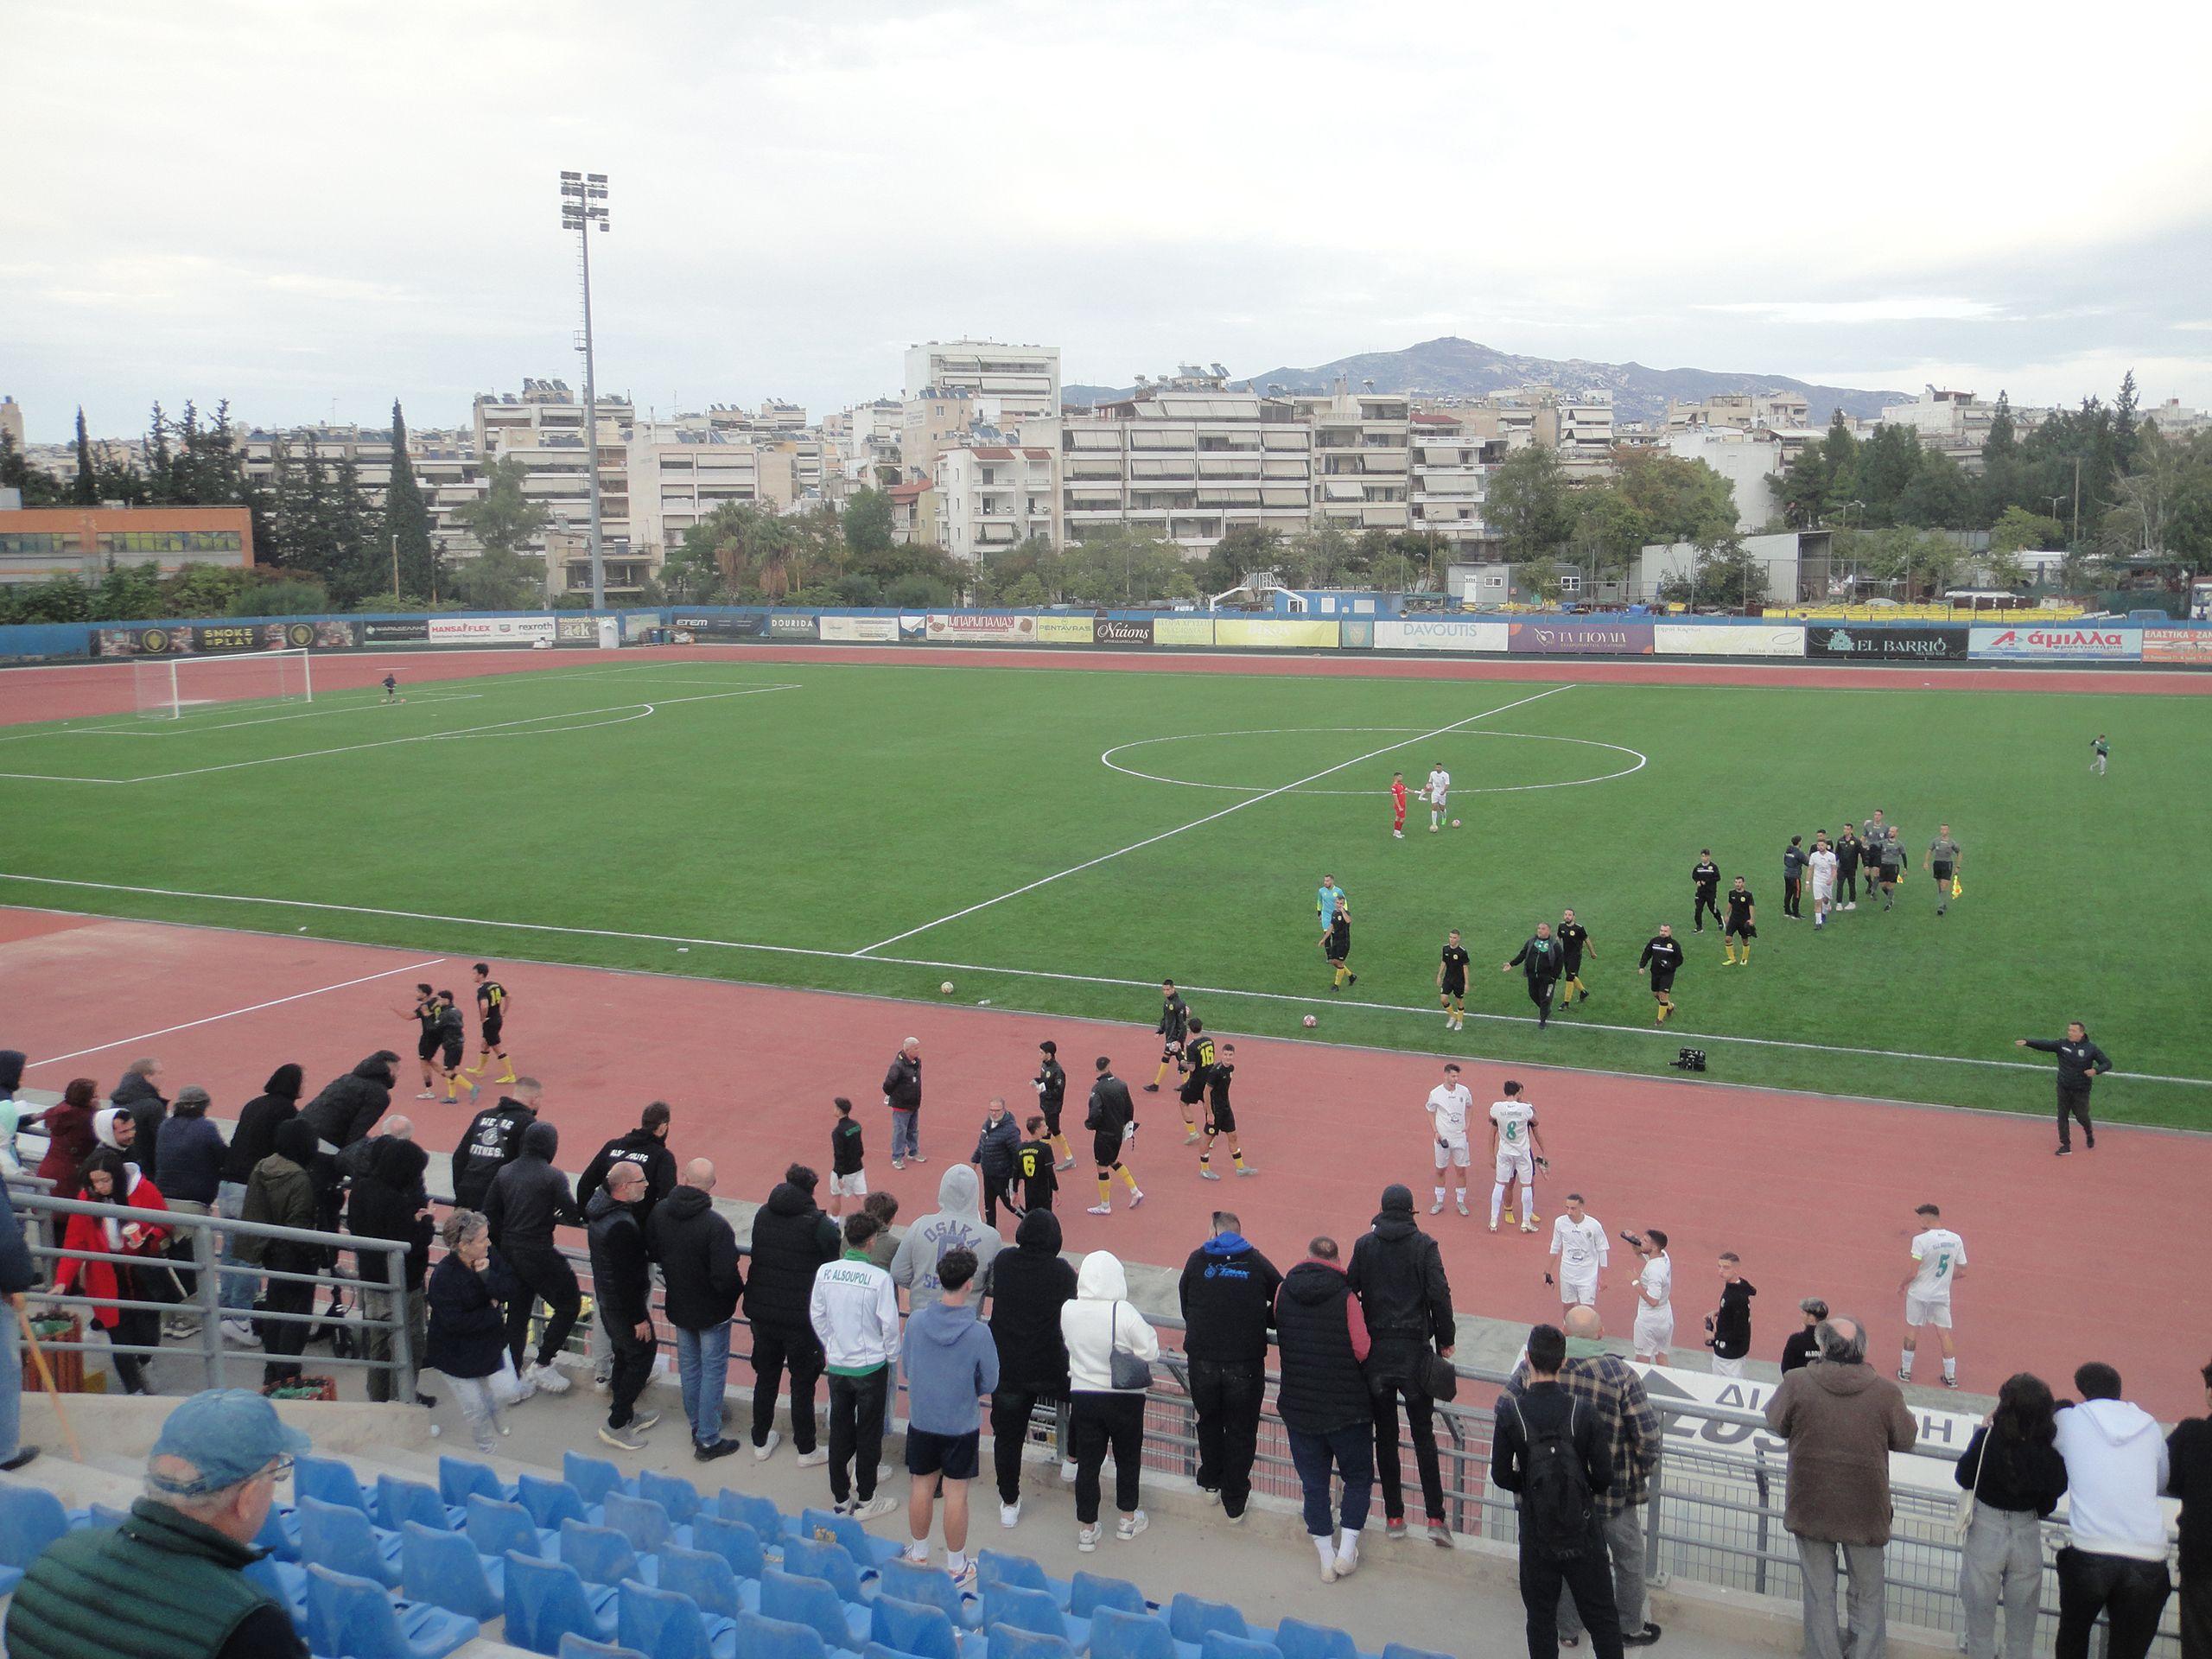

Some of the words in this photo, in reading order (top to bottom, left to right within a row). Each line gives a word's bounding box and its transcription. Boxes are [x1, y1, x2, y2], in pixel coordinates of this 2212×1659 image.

[949, 616, 1014, 627] ΜΠΑΡΜΠΑΛΙΑΣ
[204, 628, 253, 638] SMOKE
[1403, 624, 1477, 637] DAVOUTIS
[1859, 639, 1878, 652] EL
[2027, 631, 2123, 648] άμιλλα
[1200, 1046, 1214, 1067] 16
[1506, 1121, 1516, 1140] 8
[1022, 1155, 1036, 1177] 6
[924, 1219, 982, 1250] OSAKA
[823, 1269, 832, 1280] FC
[832, 1269, 873, 1286] ALSOUPOLI
